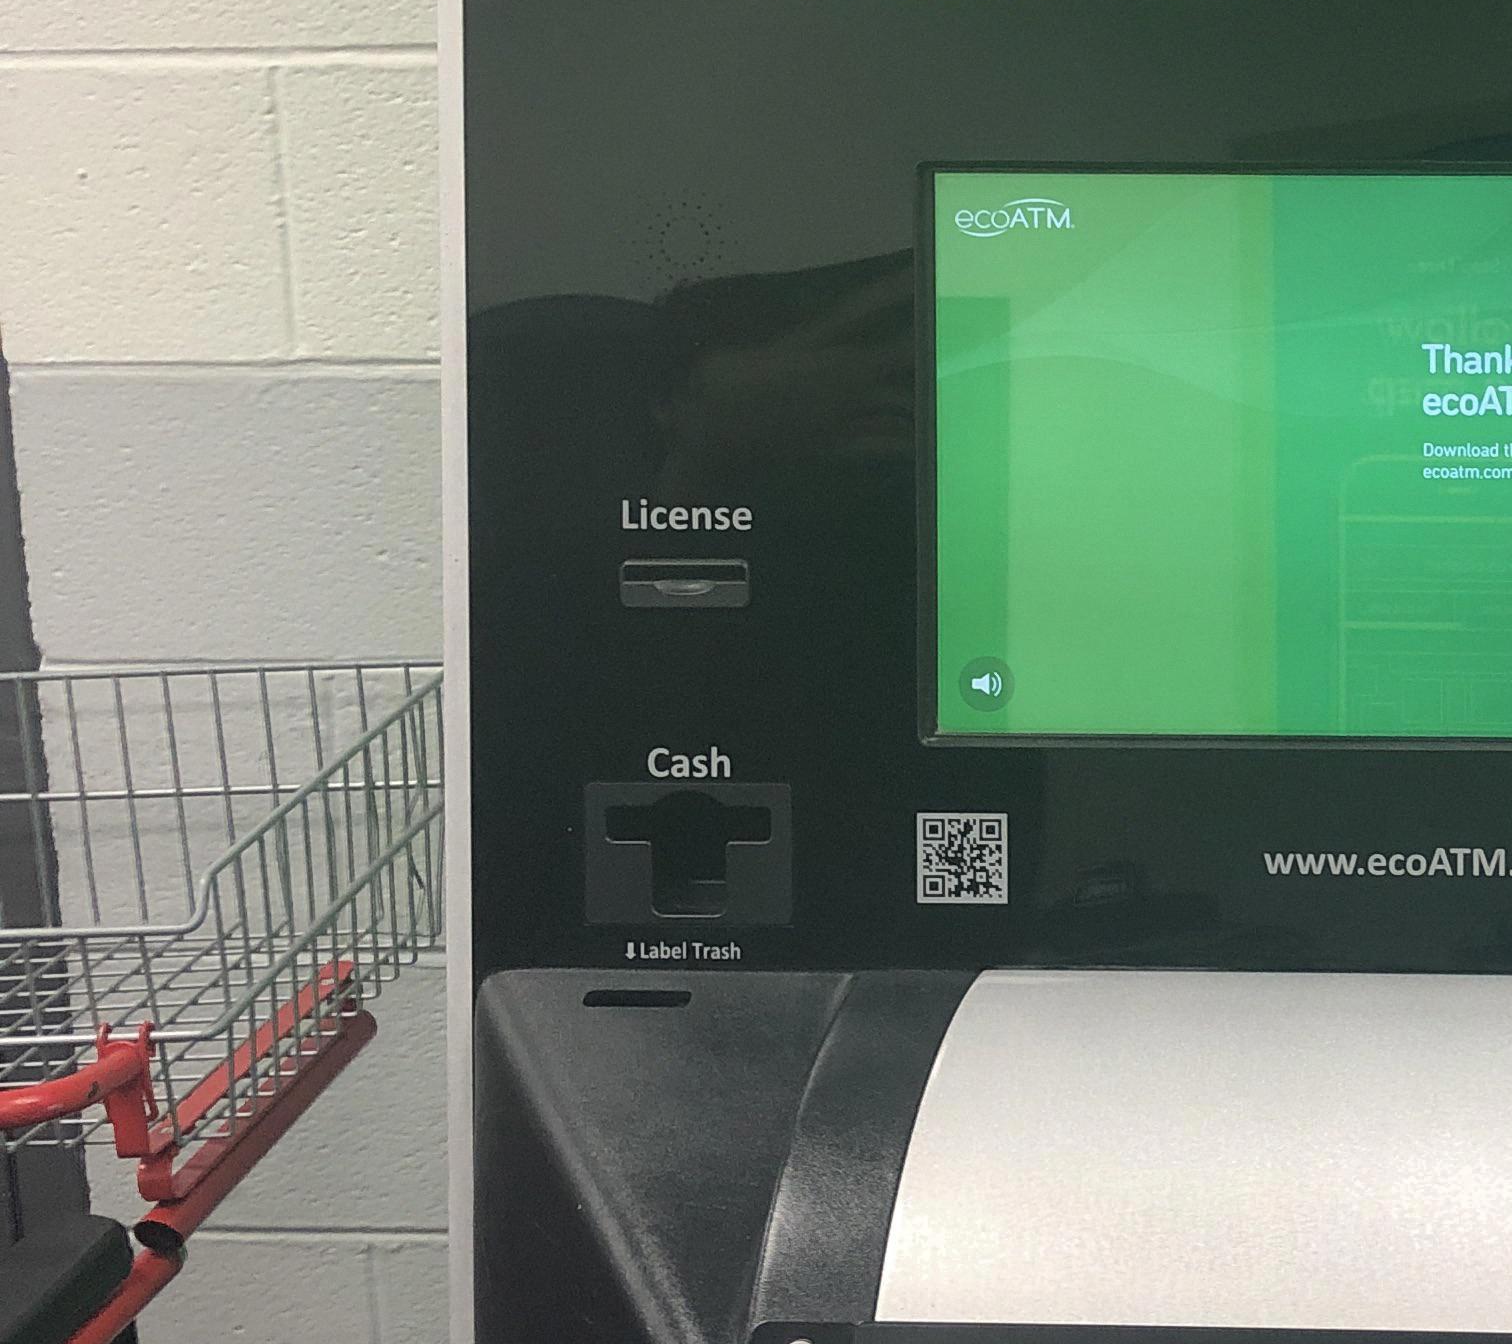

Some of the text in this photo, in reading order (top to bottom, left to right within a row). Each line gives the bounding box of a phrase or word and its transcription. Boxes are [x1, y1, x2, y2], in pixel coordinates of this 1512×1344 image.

[955, 202, 1072, 234] ecoATM
[1423, 443, 1499, 458] Download
[622, 499, 753, 531] License
[647, 746, 731, 778] Cash
[640, 942, 741, 960] Label Trash
